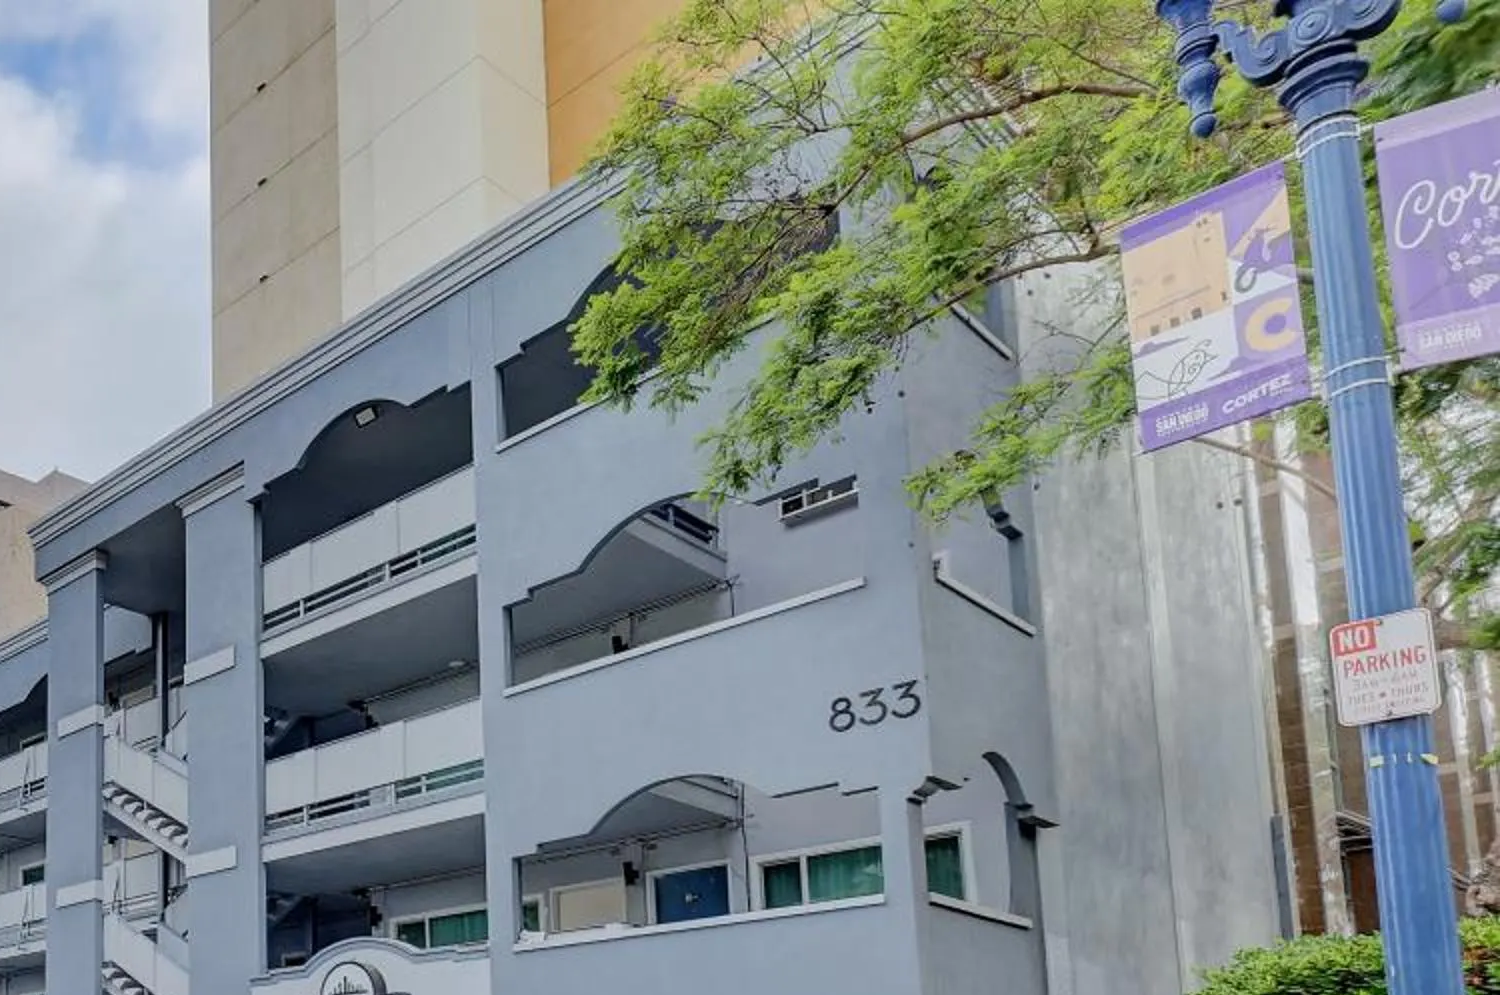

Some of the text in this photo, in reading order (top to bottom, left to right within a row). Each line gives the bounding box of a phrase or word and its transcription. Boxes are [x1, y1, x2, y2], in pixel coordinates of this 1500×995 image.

[1222, 373, 1292, 414] CORTEZ
[1338, 625, 1370, 652] NO
[1343, 645, 1426, 678] PARKING
[829, 679, 921, 732] 833
